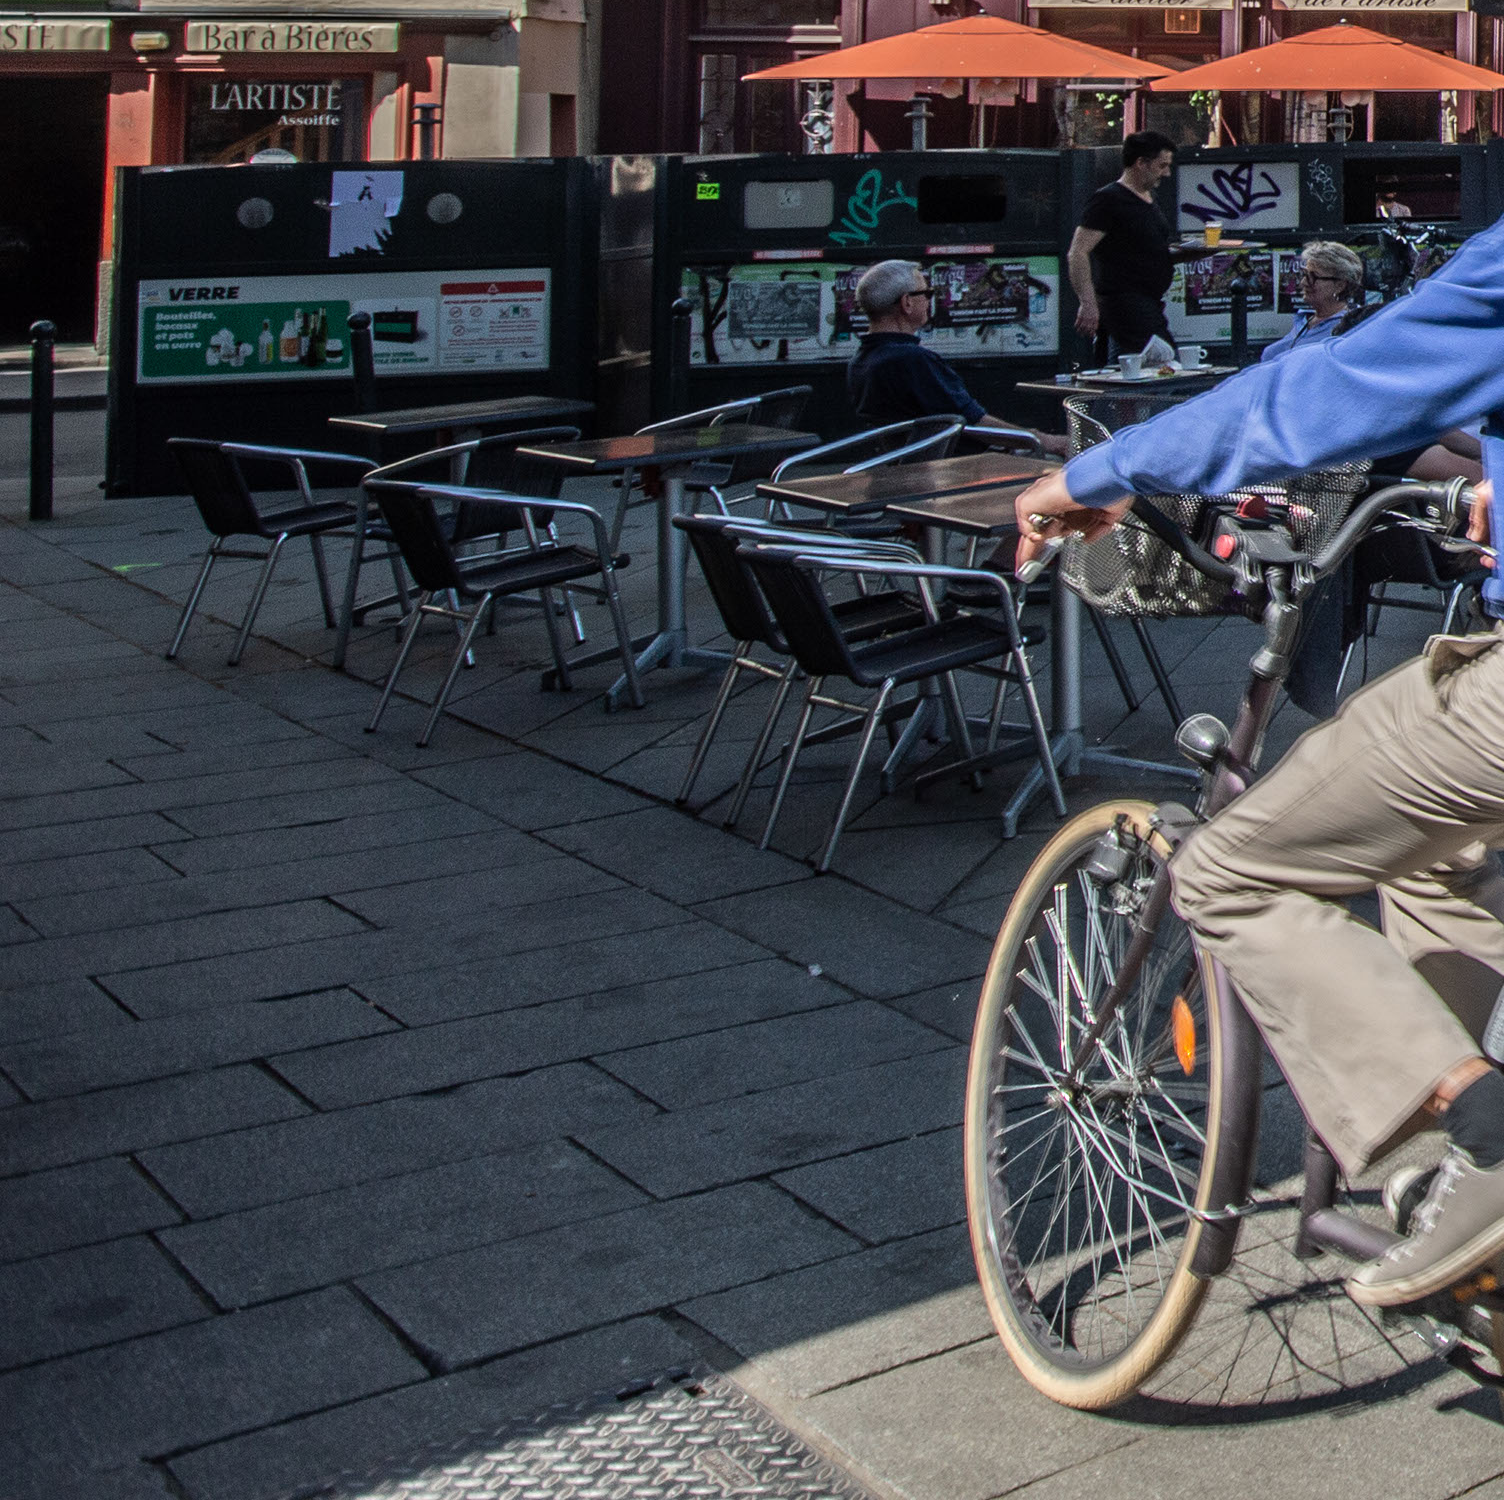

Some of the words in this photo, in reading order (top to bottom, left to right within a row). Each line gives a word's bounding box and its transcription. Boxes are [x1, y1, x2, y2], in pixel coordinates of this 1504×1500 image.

[203, 24, 255, 50] Bar
[210, 83, 342, 111] L'ARTISTE
[168, 287, 240, 301] VERRE
